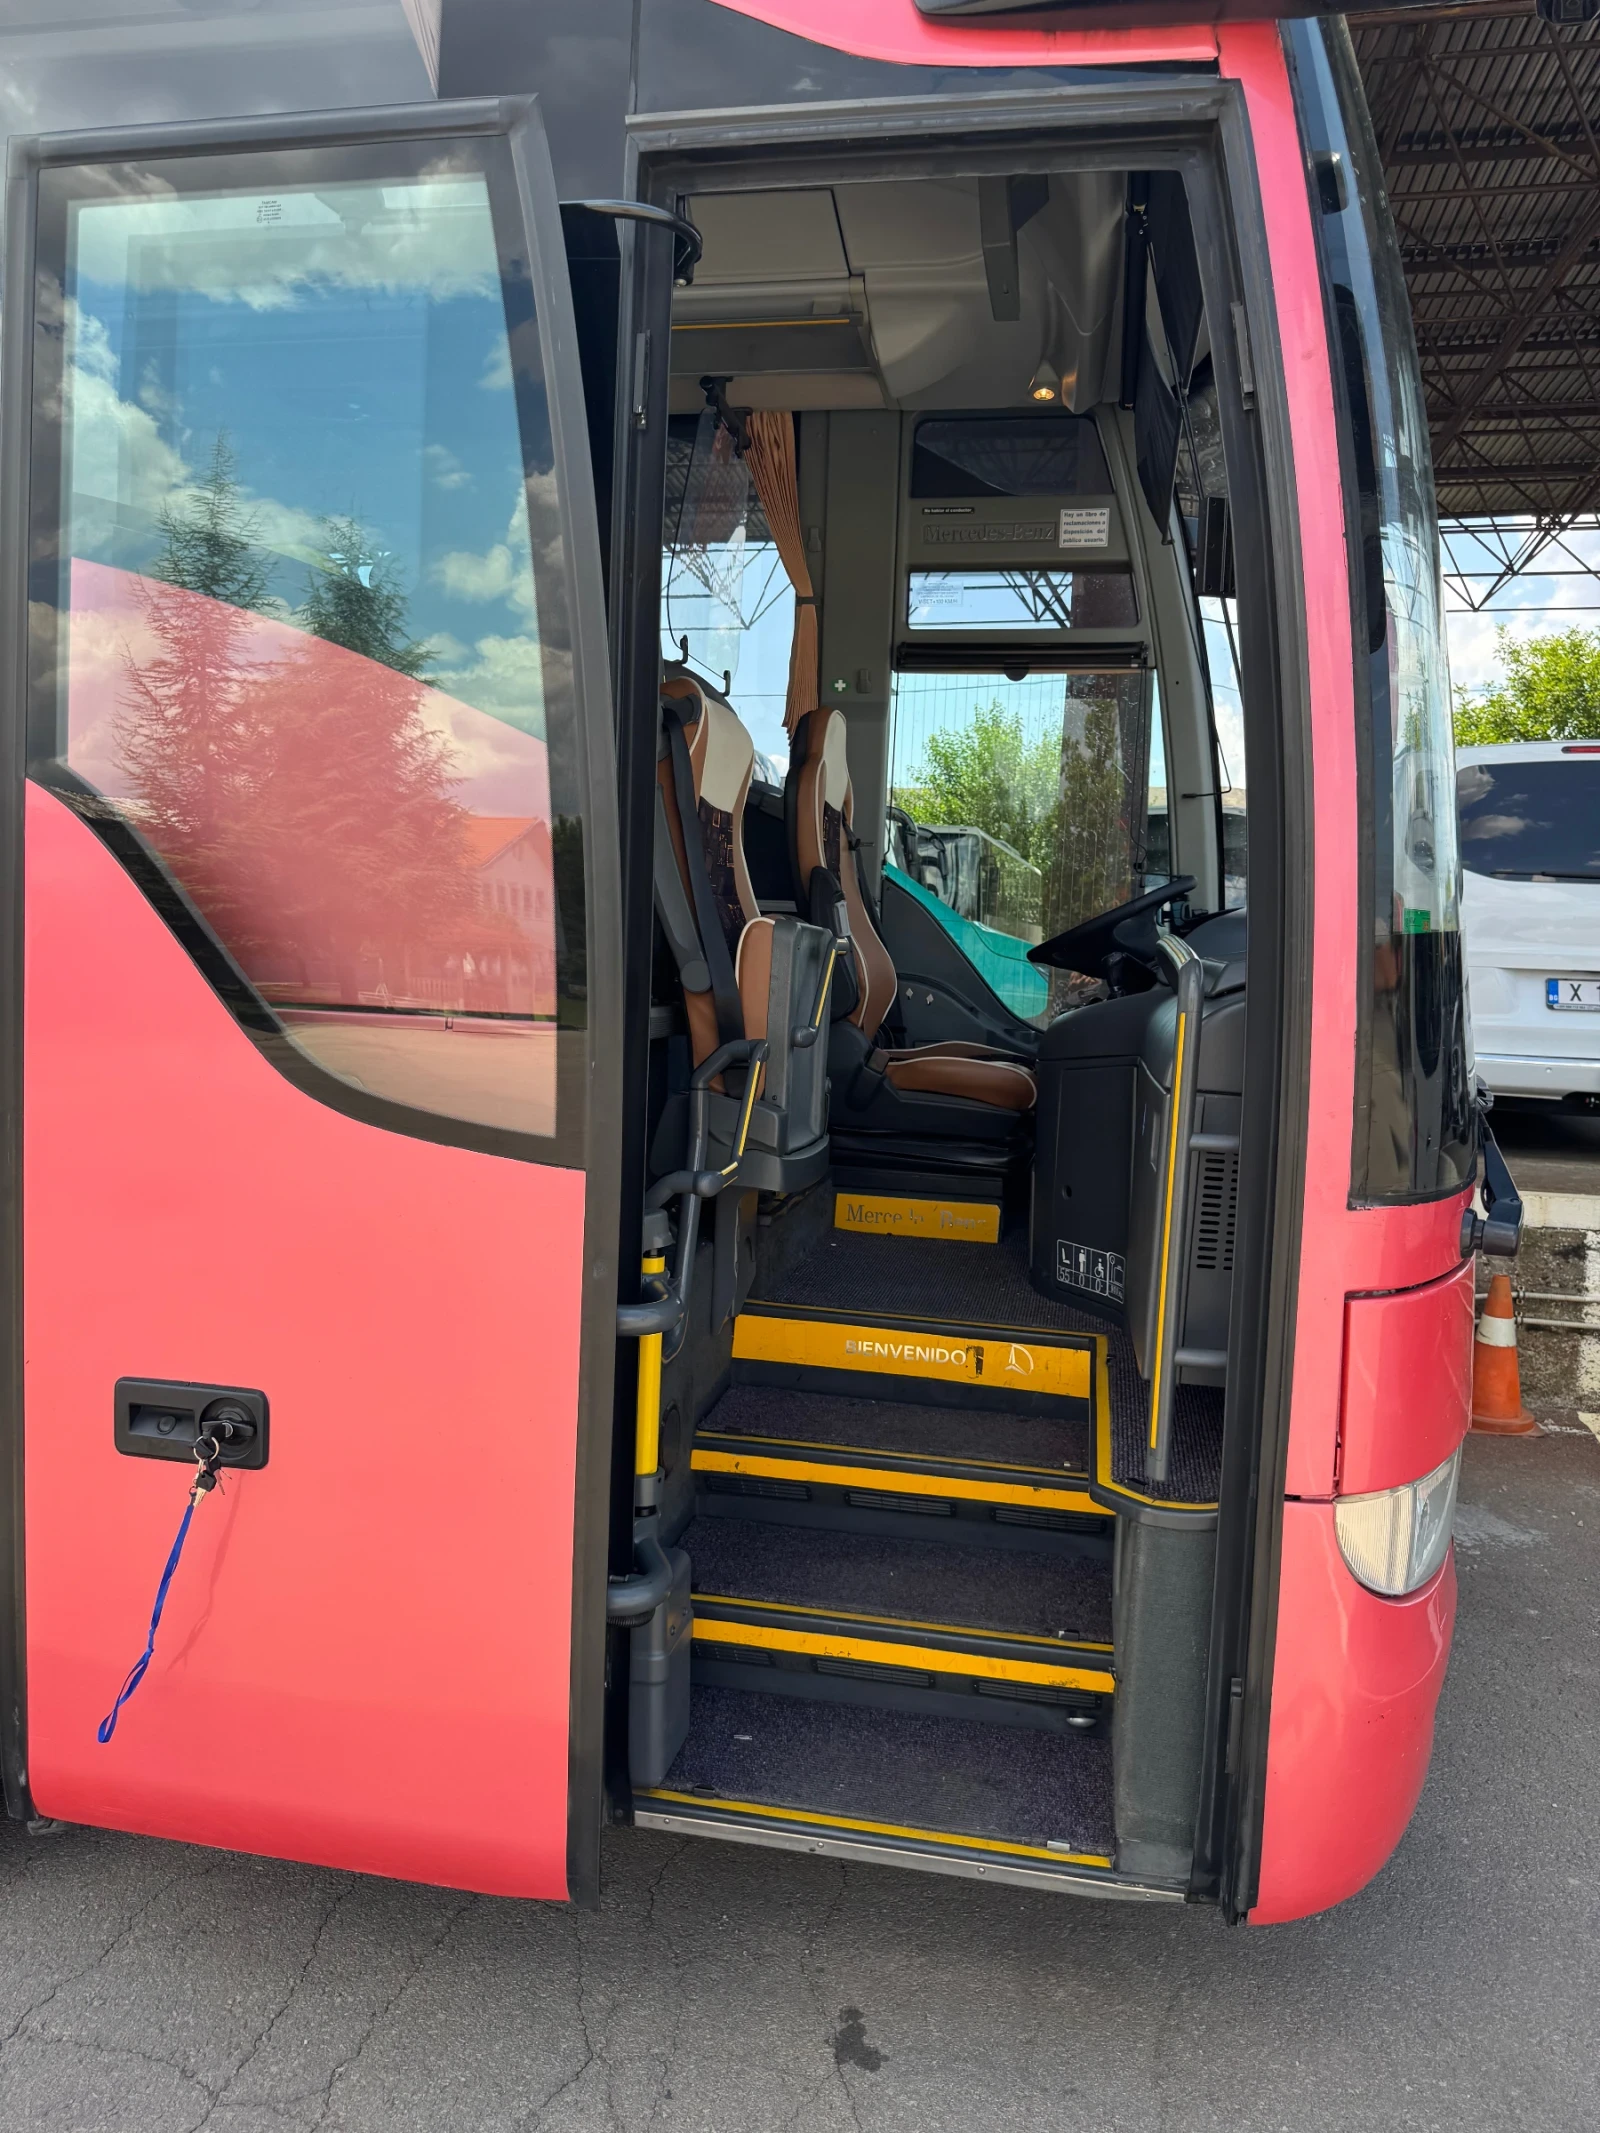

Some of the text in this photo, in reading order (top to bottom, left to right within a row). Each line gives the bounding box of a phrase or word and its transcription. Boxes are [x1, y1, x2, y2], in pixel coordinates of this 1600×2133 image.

[926, 524, 1055, 541] Mercedes-Benz
[1060, 1267, 1070, 1282] 55
[845, 1340, 967, 1366] BIENVENIDO
